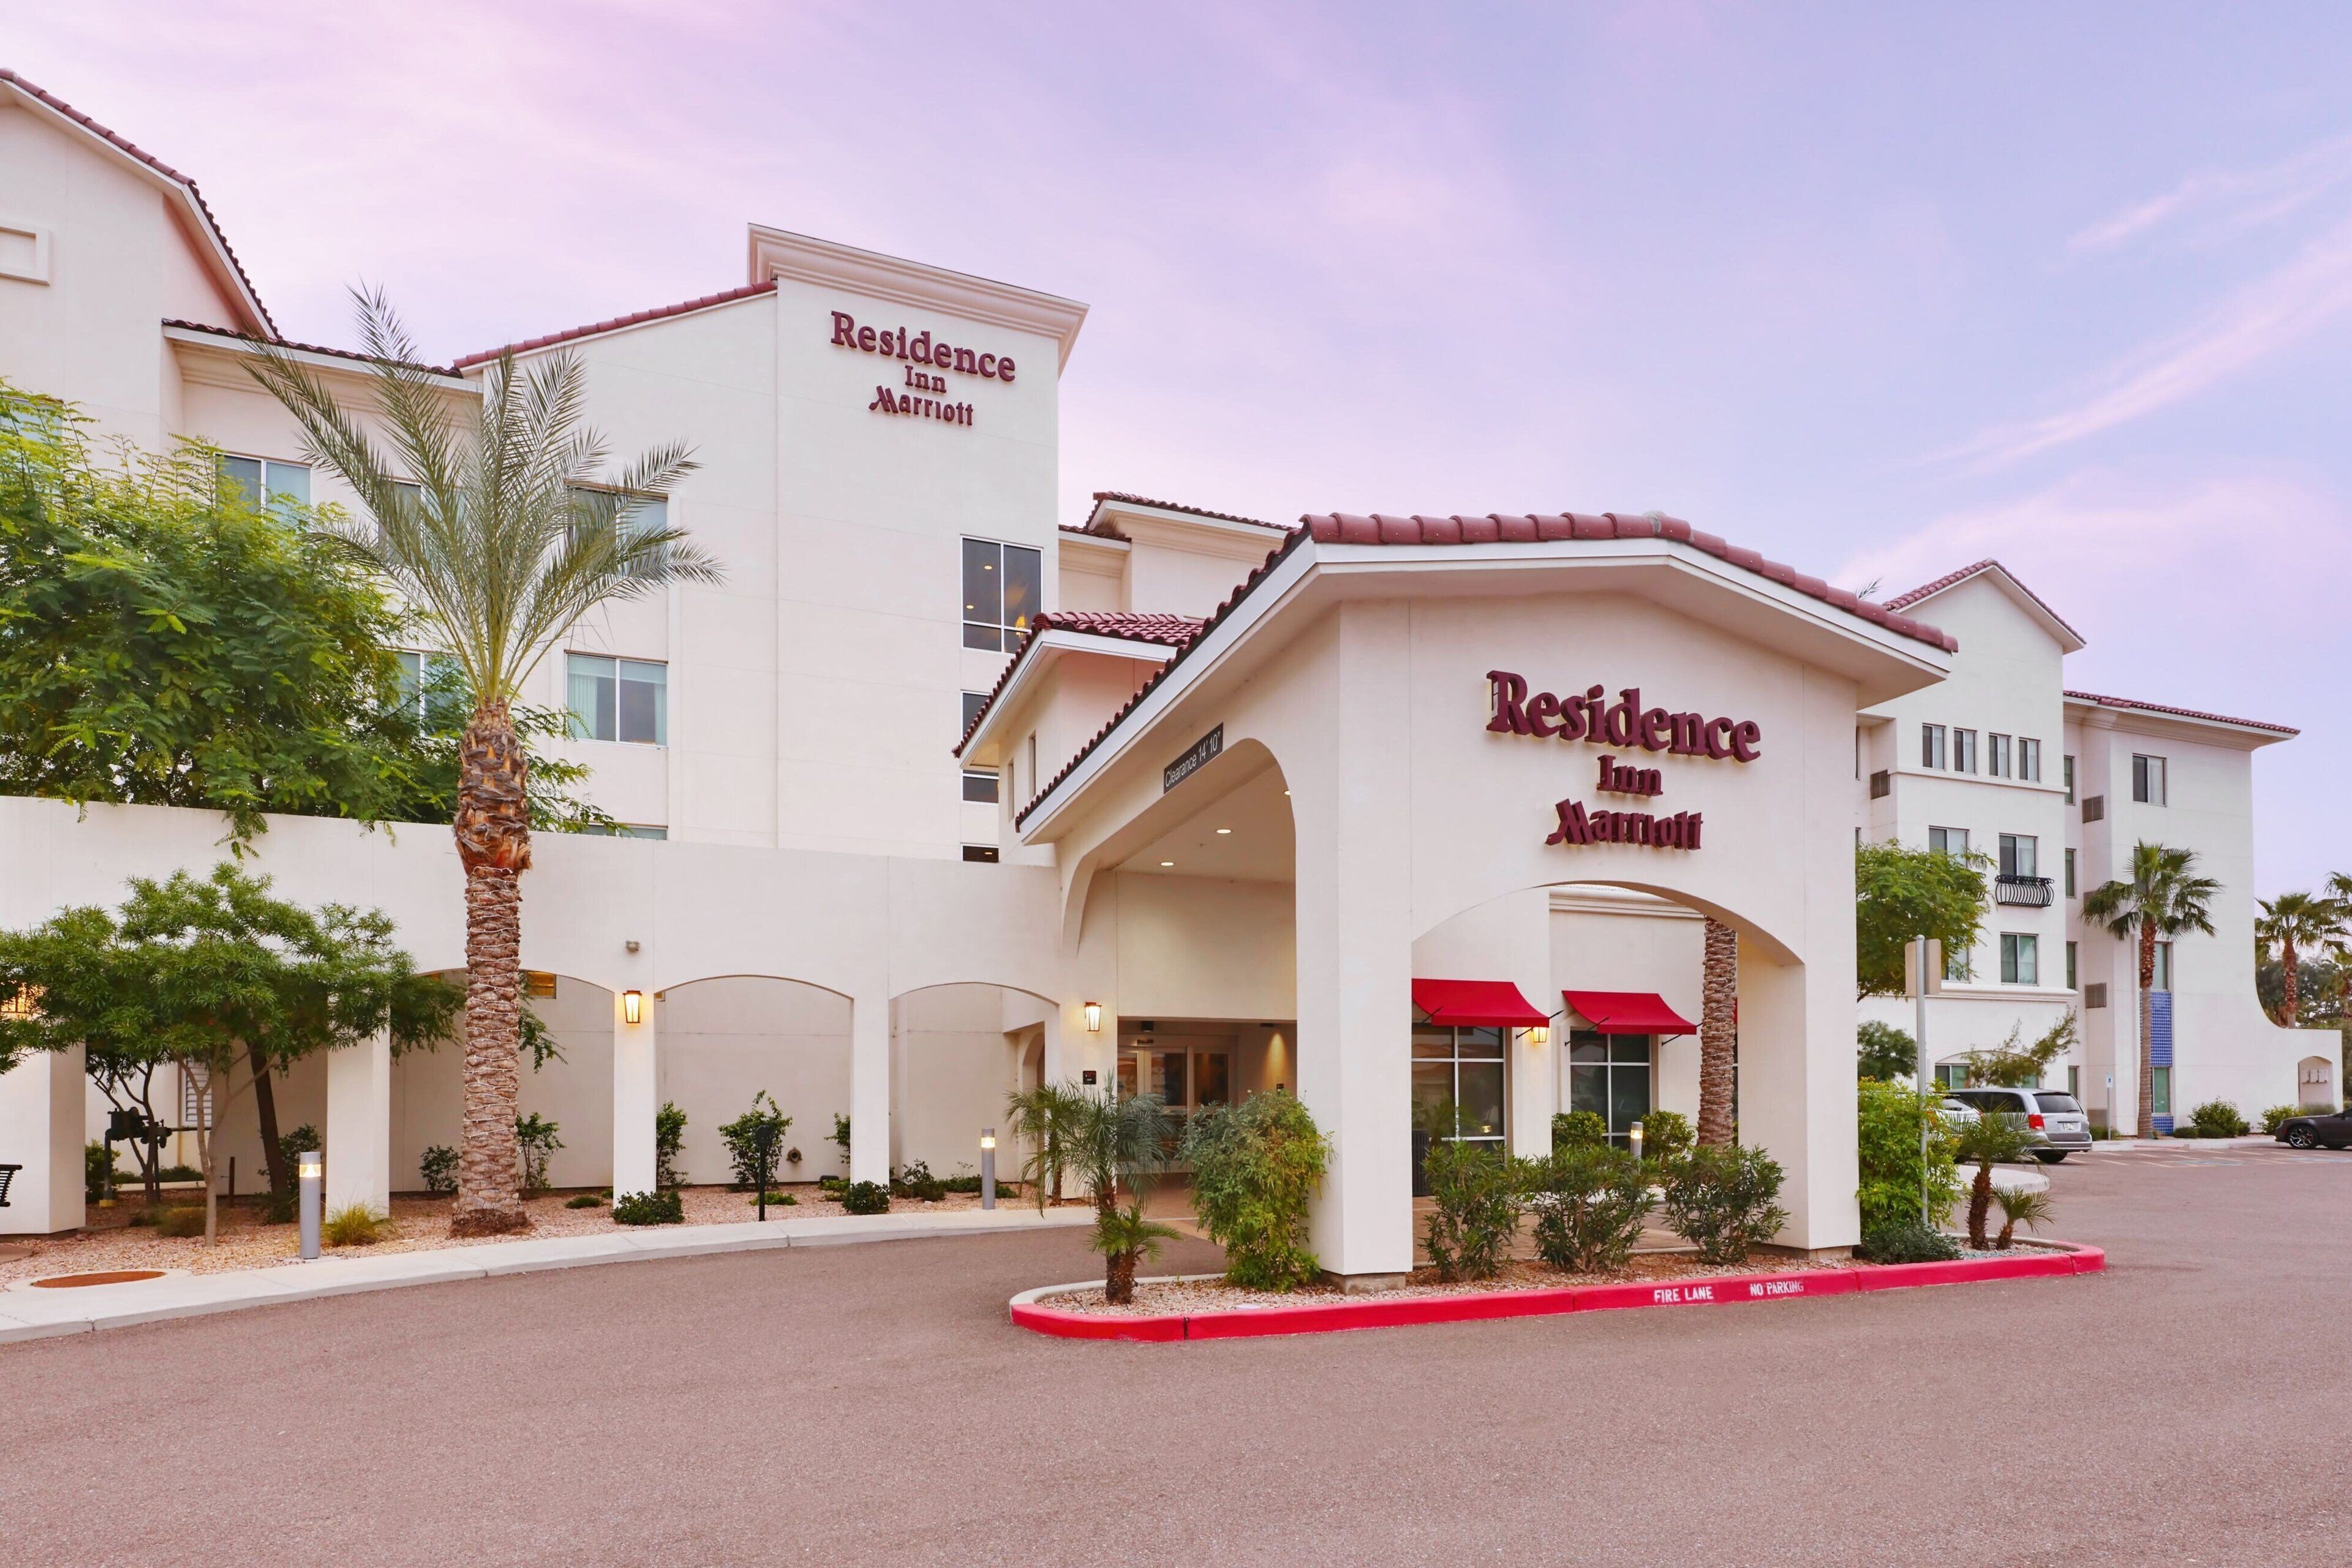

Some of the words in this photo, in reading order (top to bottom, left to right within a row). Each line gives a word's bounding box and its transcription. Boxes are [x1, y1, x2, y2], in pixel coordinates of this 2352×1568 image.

[831, 310, 1016, 383] Residence
[905, 364, 947, 394] Inn
[869, 385, 974, 426] Marriott
[1486, 669, 1761, 764] Residence
[1165, 754, 1197, 788] Clearance
[1198, 740, 1208, 762] 14'
[1596, 754, 1664, 797] Inn
[1545, 798, 1703, 851] Marriott
[1654, 1288, 1680, 1303] FIRE
[1684, 1286, 1714, 1300] LANE
[1749, 1283, 1764, 1296] NO
[1766, 1280, 1804, 1295] PARKING
